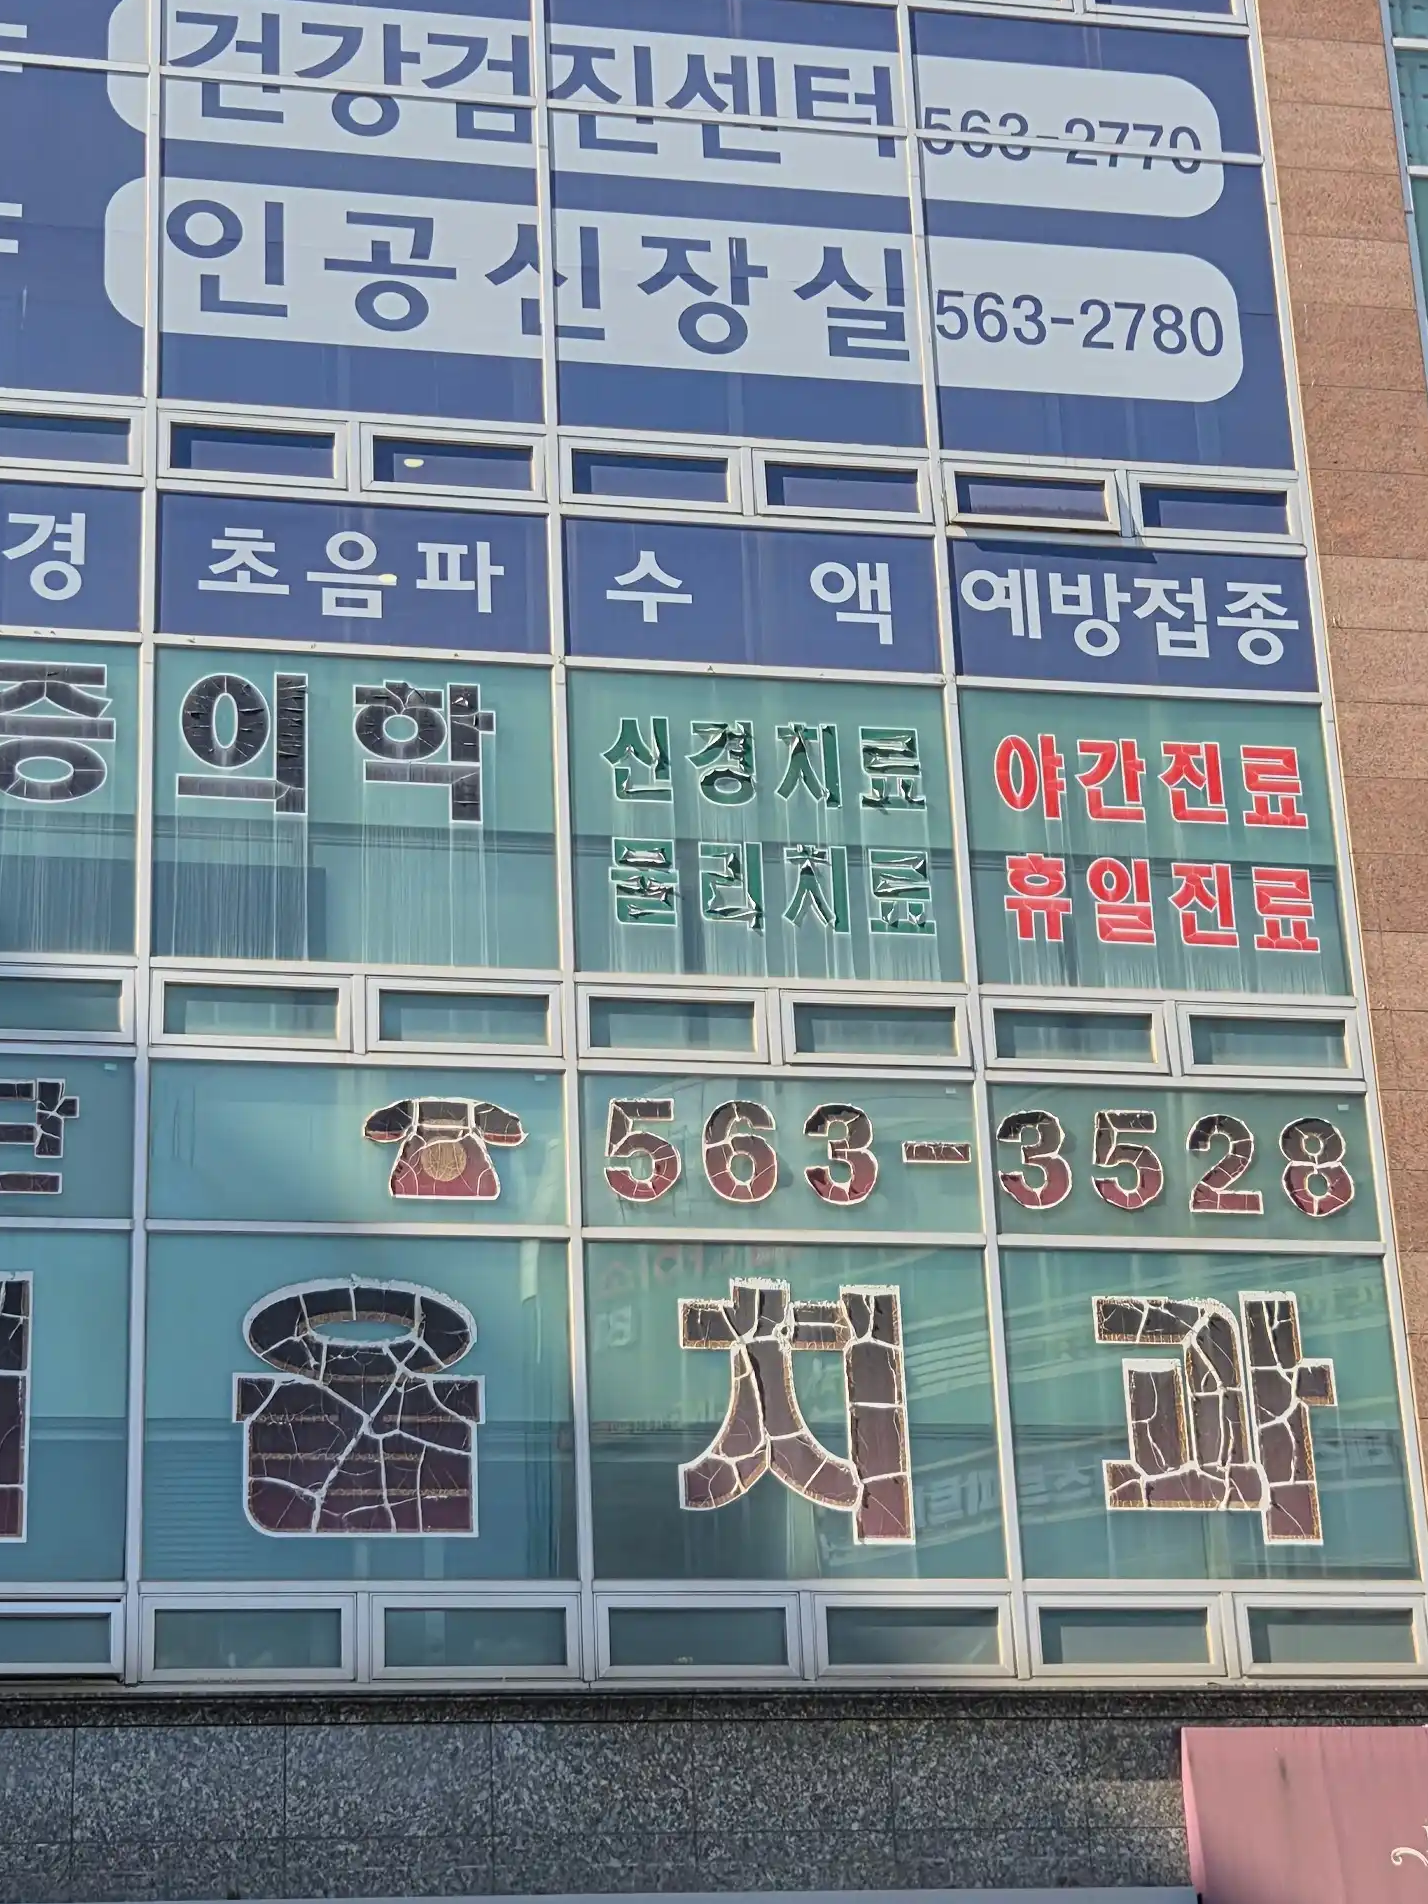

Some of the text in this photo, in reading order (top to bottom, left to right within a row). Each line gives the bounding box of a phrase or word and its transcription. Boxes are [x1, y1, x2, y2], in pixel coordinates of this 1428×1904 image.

[166, 5, 1204, 176] 건강검진센터 563-2770
[163, 198, 1226, 362] 인공신장실 563-2780
[196, 525, 506, 621] 초음파
[959, 559, 1302, 667] 예방접종
[603, 715, 930, 813] 신경치료
[993, 730, 1312, 833] 야간진료
[1001, 851, 1324, 955] 휴일진료
[602, 1093, 1357, 1220] 563-3528
